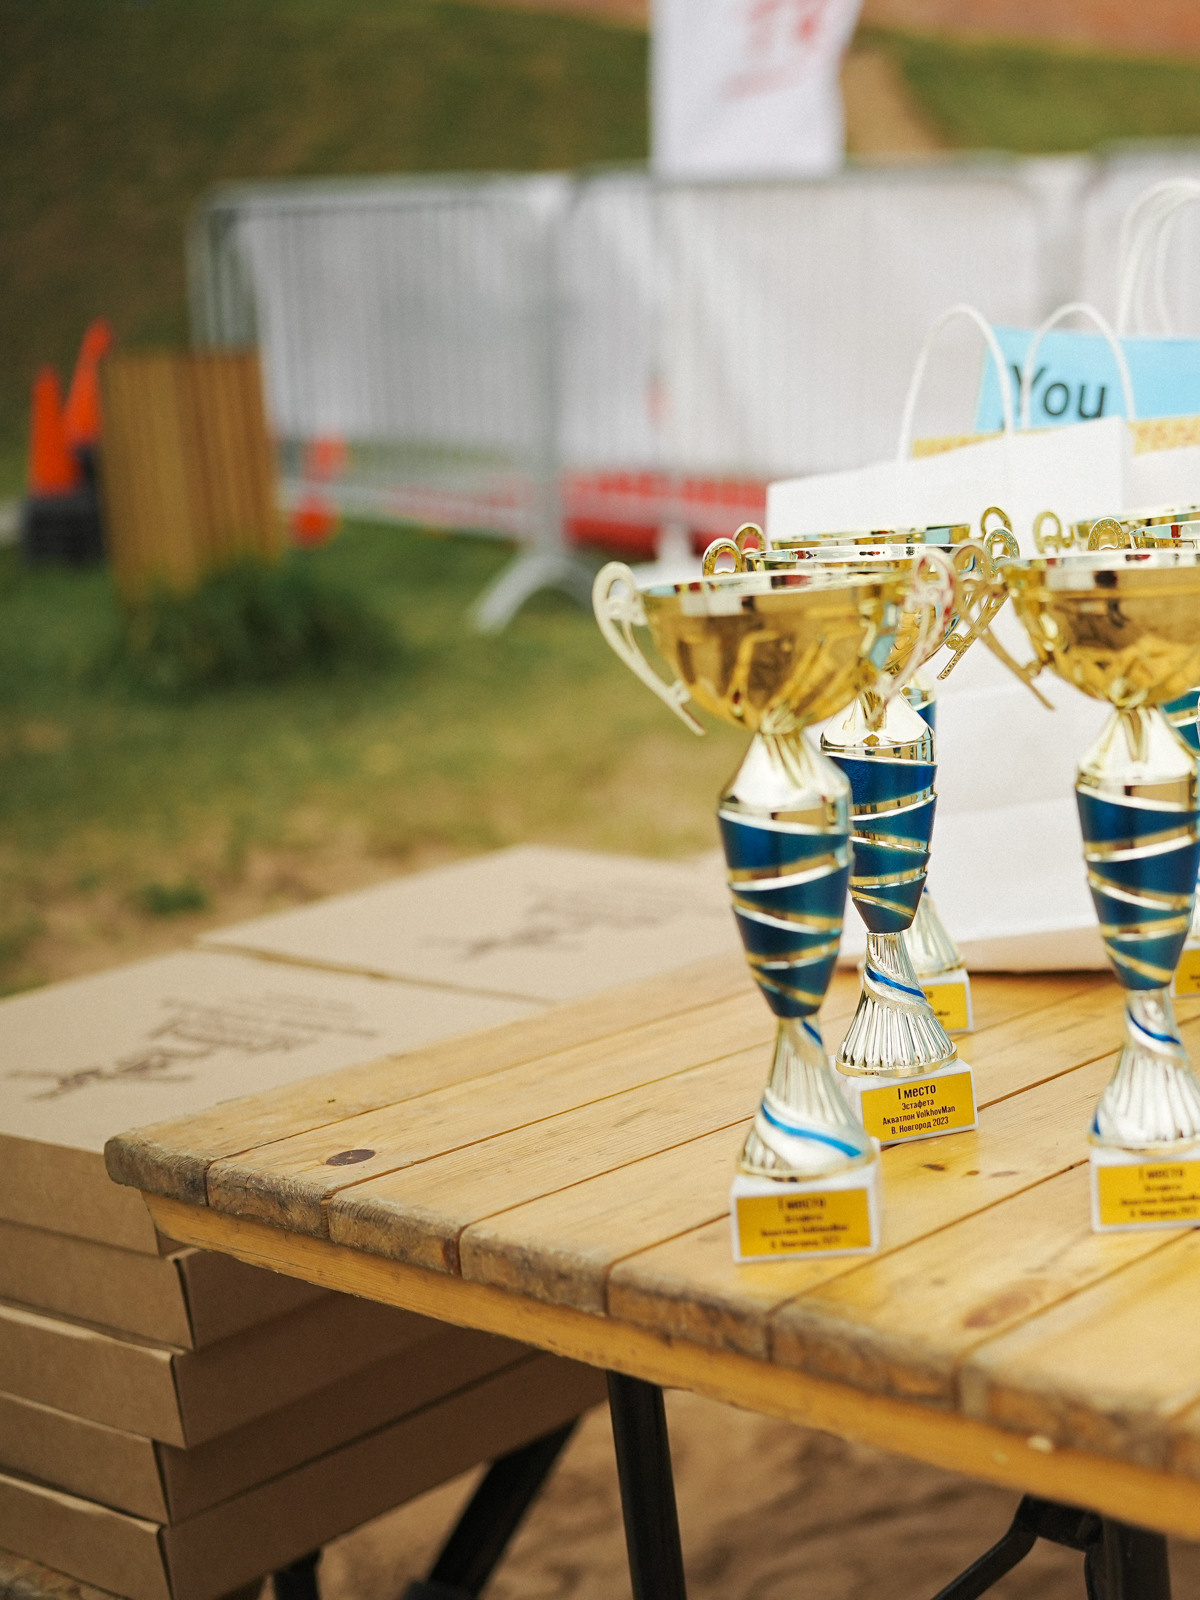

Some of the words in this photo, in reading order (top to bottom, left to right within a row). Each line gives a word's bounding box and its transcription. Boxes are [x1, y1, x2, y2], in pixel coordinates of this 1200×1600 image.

[1012, 363, 1107, 419] You
[904, 1084, 936, 1099] место
[901, 1099, 935, 1111] Эстафета
[882, 1114, 916, 1126] Акватлон
[916, 1106, 956, 1119] VolkhovMan
[891, 1126, 898, 1134] В.
[899, 1121, 932, 1133] Новгород
[933, 1117, 949, 1127] 2023
